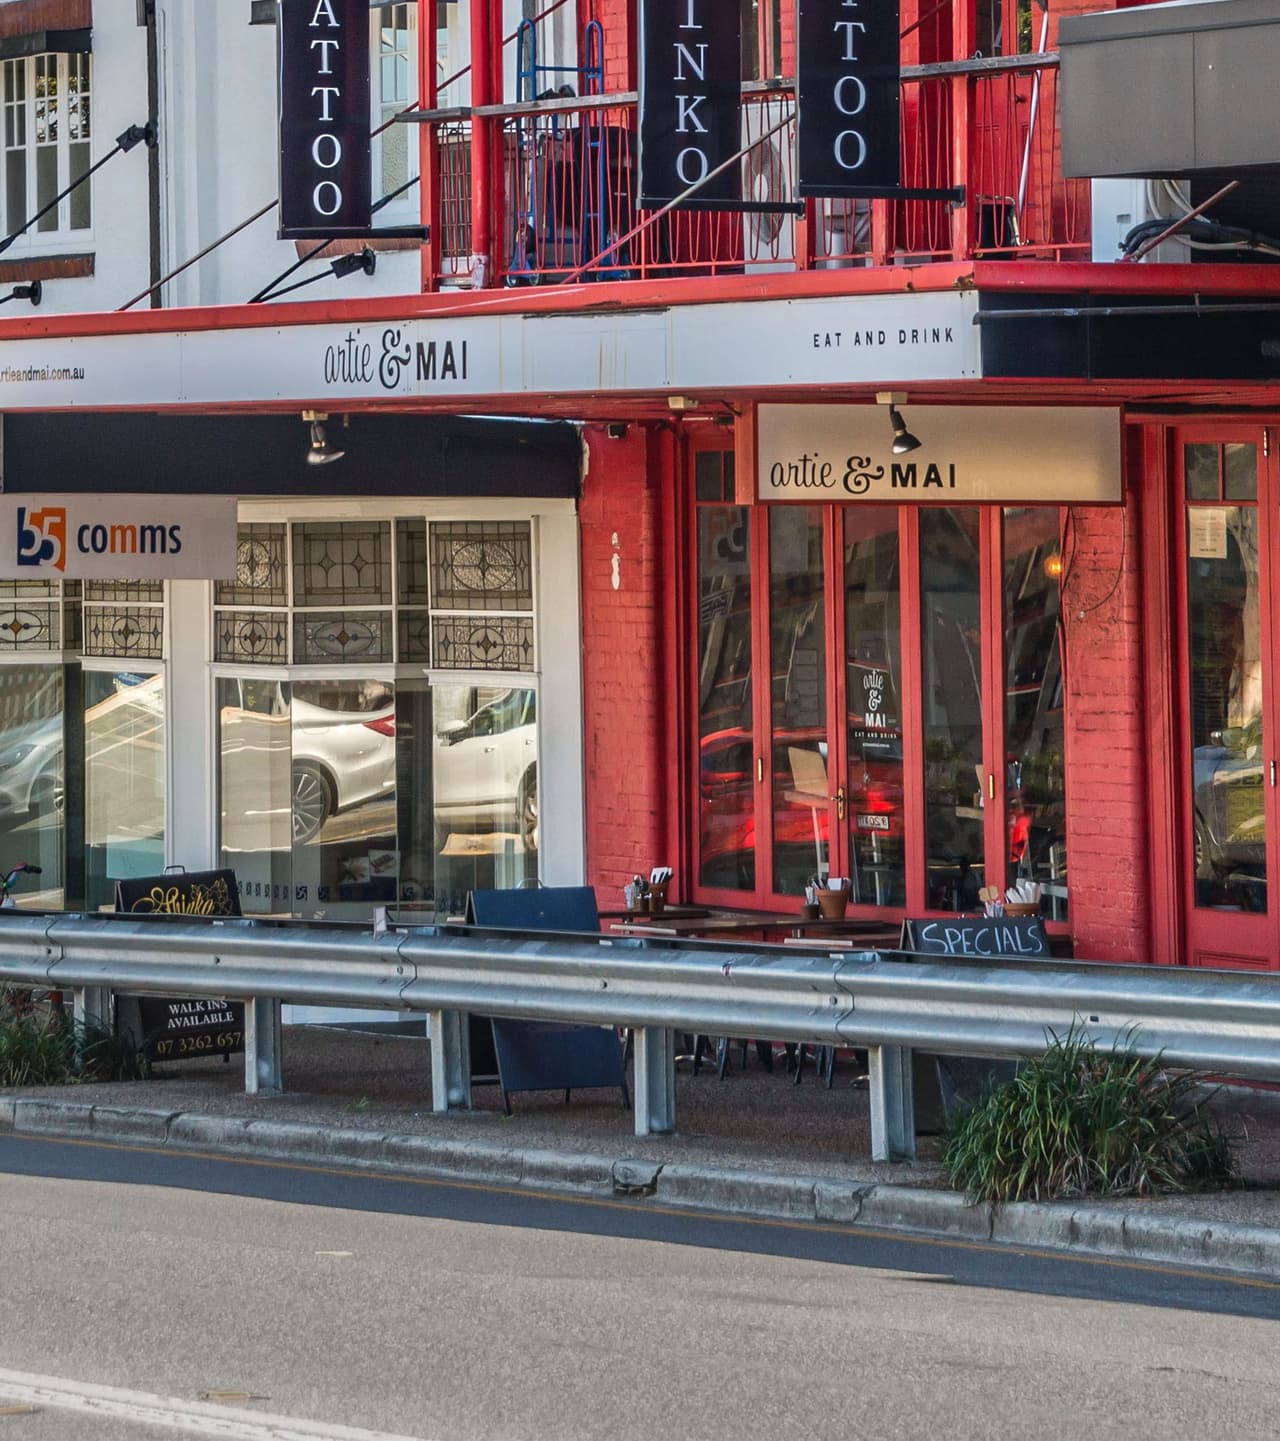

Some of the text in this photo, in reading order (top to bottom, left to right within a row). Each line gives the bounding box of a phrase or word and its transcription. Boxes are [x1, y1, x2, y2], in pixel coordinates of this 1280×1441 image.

[813, 327, 954, 348] EAT AND DRINK
[324, 327, 468, 389] artie & MAI
[771, 452, 955, 494] artie & MAI
[77, 524, 182, 554] comms
[863, 668, 885, 690] artie
[865, 712, 886, 728] MAI
[921, 923, 1043, 955] SPECIALS
[168, 999, 228, 1015] WALK INS
[167, 1011, 235, 1029] AVAILABLE
[157, 1031, 246, 1055] 07 3262 657
